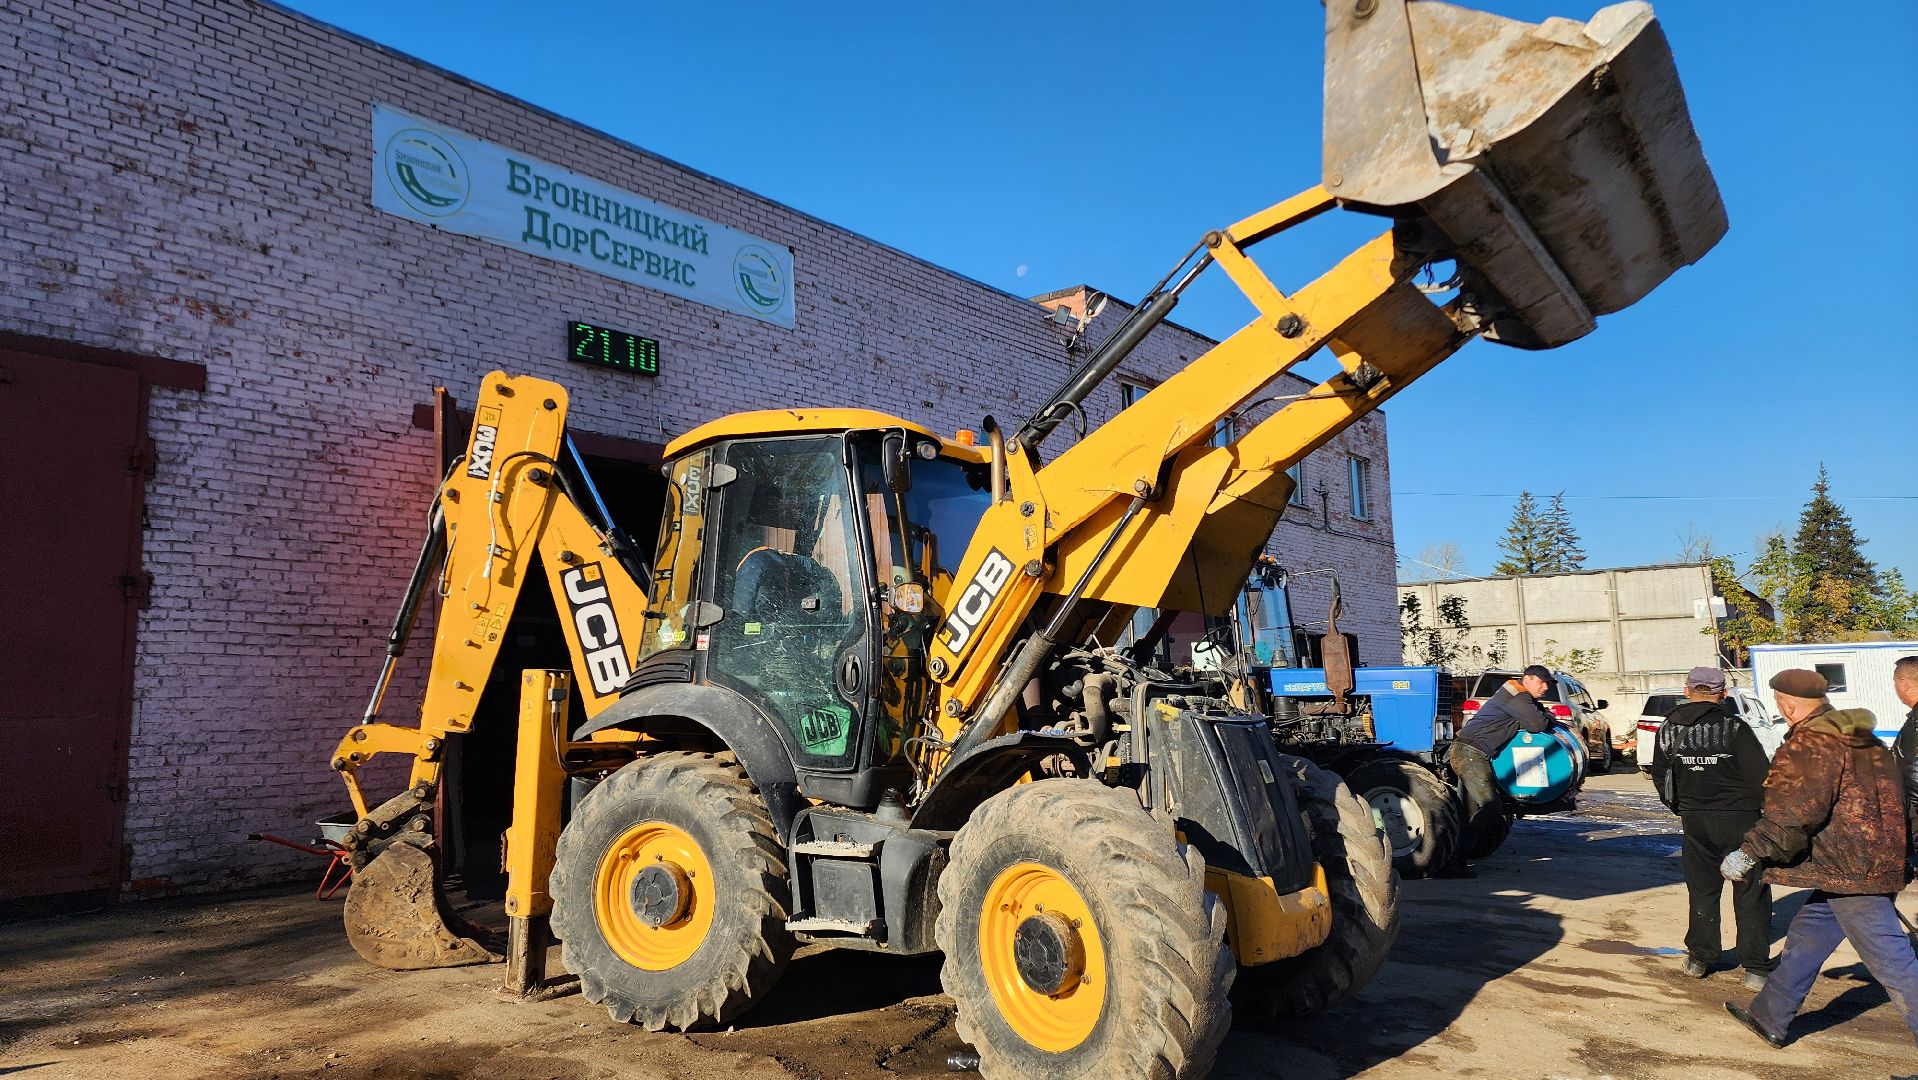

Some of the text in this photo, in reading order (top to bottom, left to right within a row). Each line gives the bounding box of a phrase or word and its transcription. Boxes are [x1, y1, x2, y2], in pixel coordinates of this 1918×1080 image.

[576, 323, 656, 372] 21.10
[564, 569, 631, 694] JCB
[948, 551, 1012, 653] JCB
[805, 710, 839, 742] JCB
